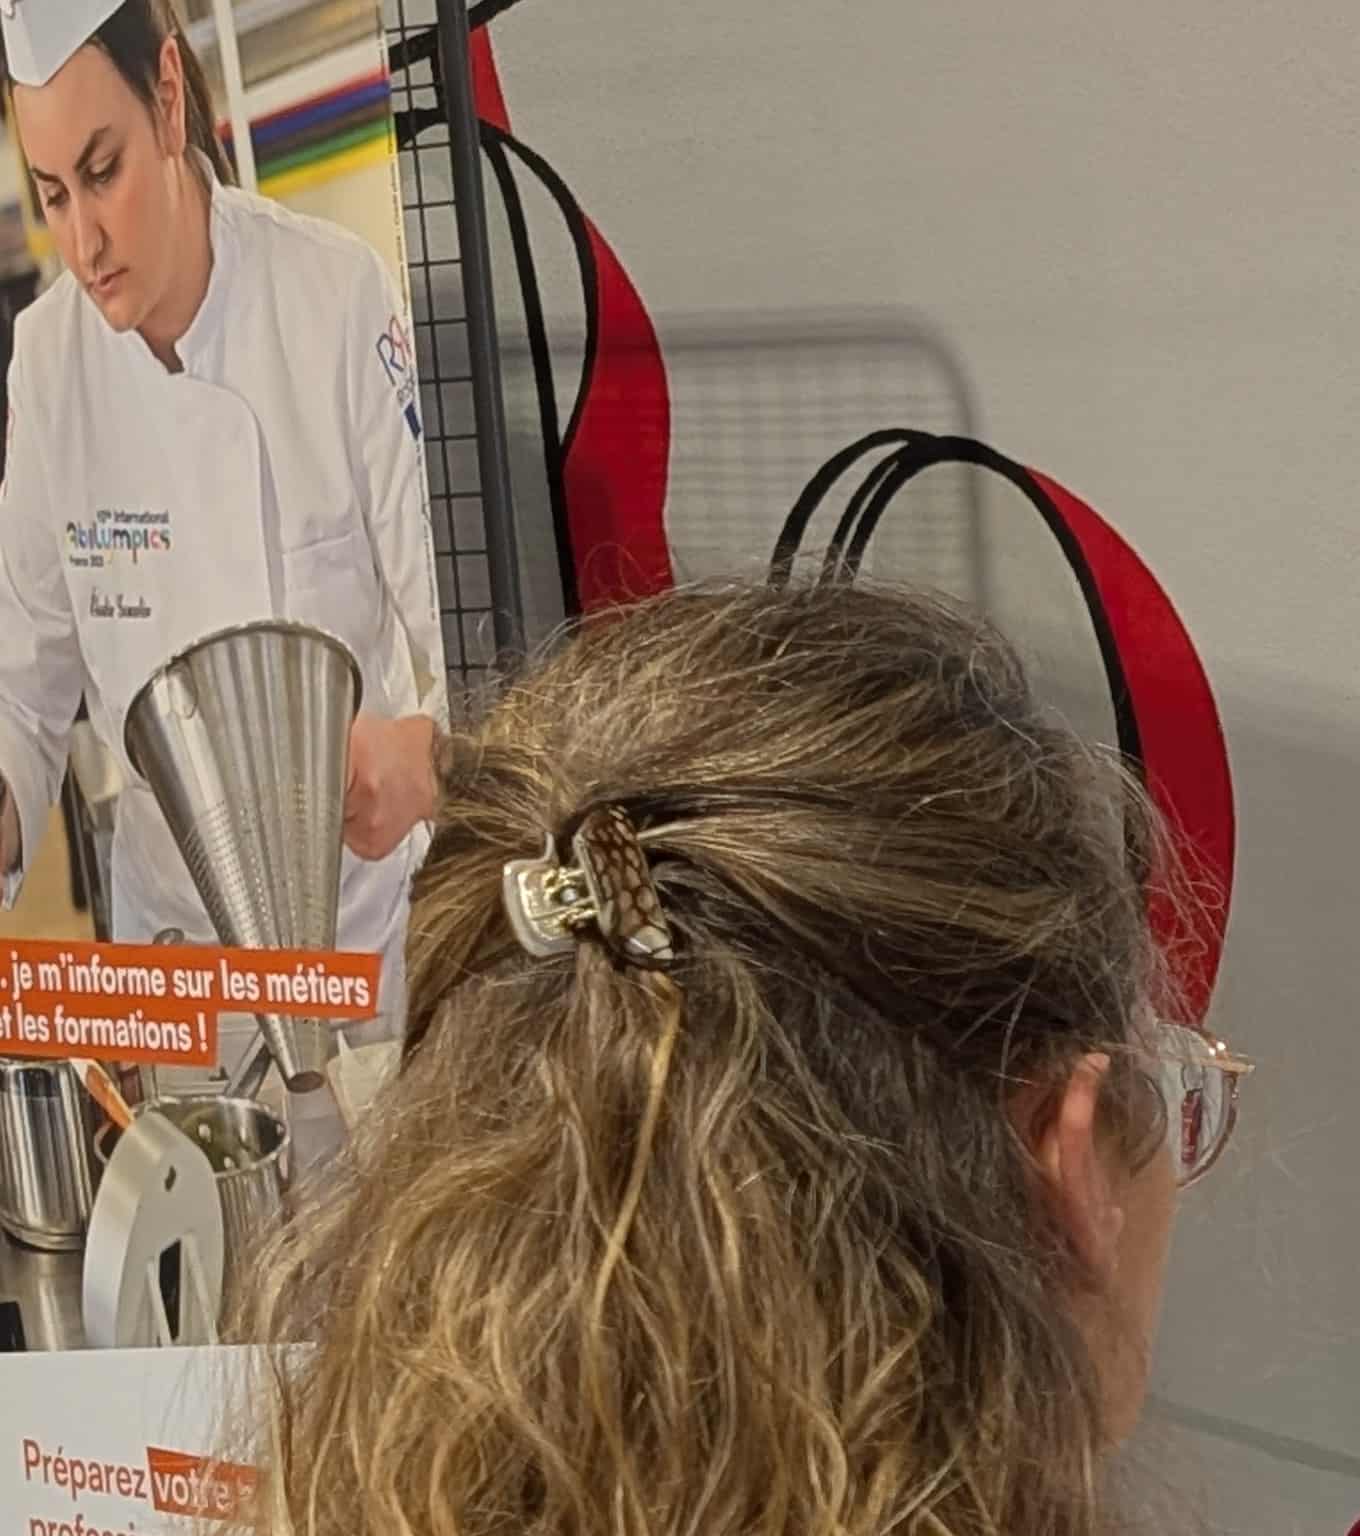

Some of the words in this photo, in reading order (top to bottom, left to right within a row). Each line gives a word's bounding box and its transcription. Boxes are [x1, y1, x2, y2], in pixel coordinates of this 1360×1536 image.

[12, 951, 34, 1001] je
[173, 967, 214, 998] sur
[219, 959, 260, 1001] les
[266, 962, 370, 1007] métiers
[17, 1002, 50, 1043] les
[55, 1004, 193, 1051] formations
[23, 1439, 148, 1501] Préparez
[153, 1467, 230, 1511] votre
